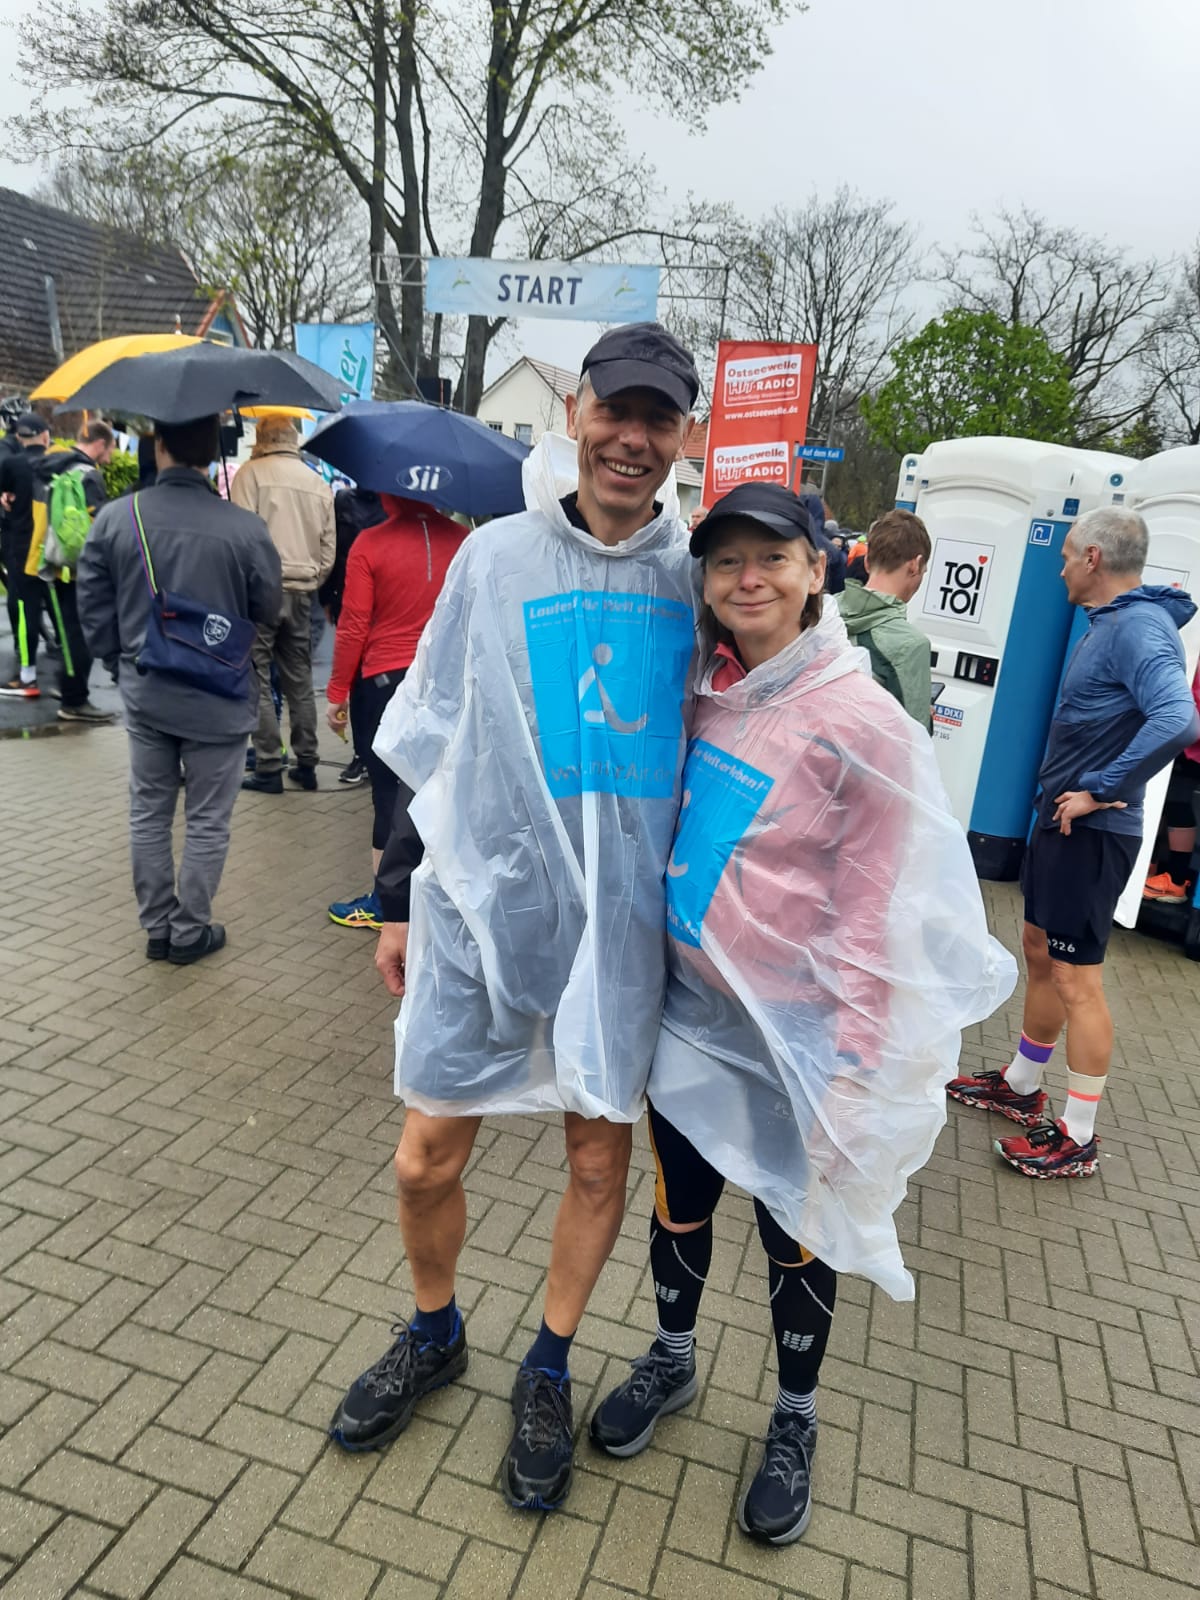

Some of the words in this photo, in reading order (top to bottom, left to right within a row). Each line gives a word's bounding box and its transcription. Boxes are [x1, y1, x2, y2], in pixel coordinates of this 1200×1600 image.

[497, 274, 583, 305] START
[728, 361, 798, 377] Ostseewelle
[724, 406, 798, 420] www.ostseewelle.de
[716, 448, 785, 464] Ostseewelle
[407, 465, 441, 492] Sii
[943, 707, 963, 719] DIXI
